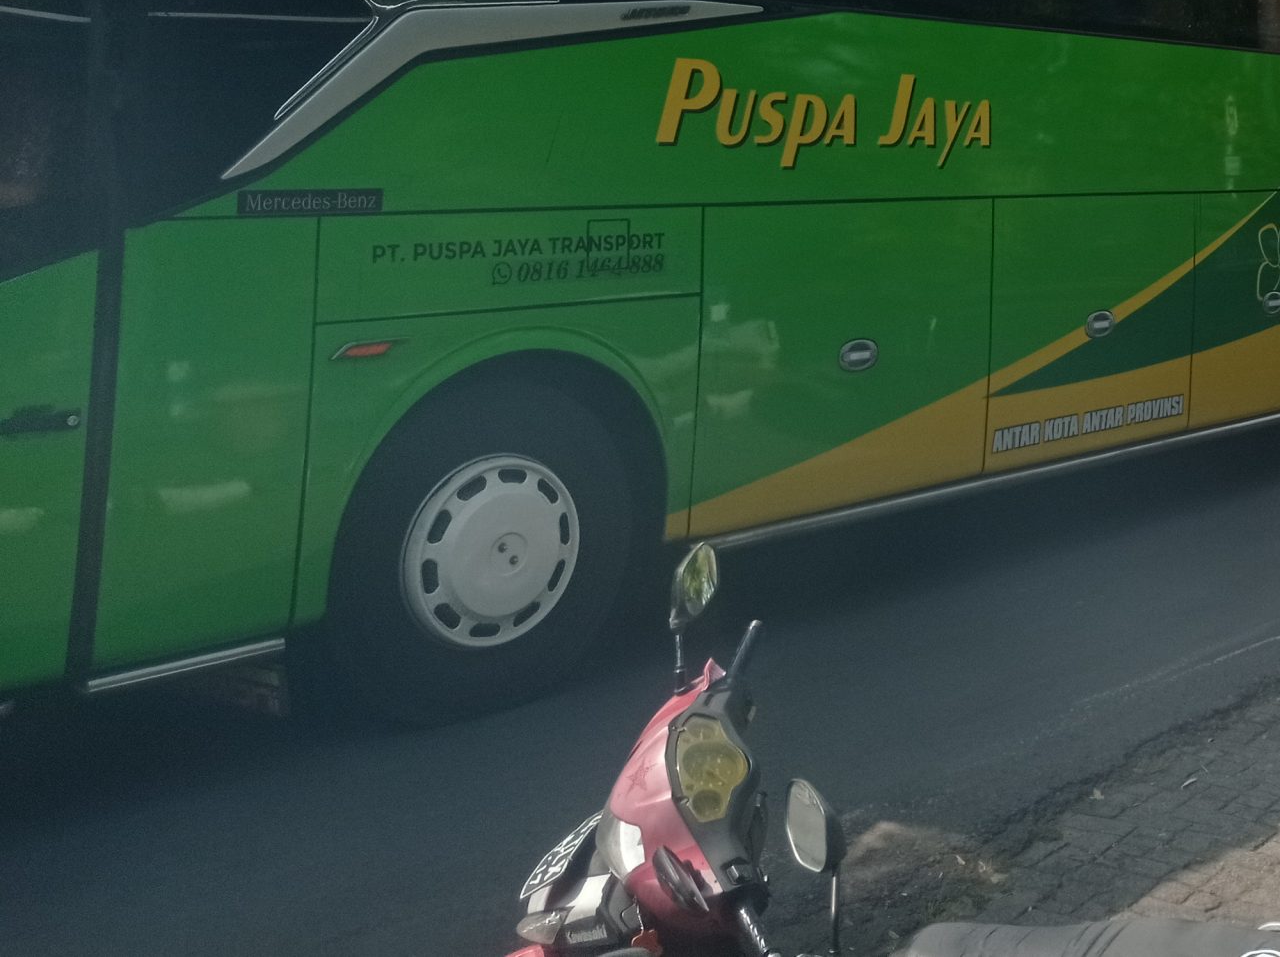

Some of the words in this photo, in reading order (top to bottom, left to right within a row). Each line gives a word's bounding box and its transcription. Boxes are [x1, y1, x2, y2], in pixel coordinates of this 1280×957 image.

[245, 192, 377, 212] Mercedes-Benz
[371, 245, 405, 264] PT.
[412, 240, 486, 262] PUSPA
[491, 238, 543, 258] JAYA
[548, 232, 665, 256] TRANSPORT
[516, 260, 570, 283] 0816
[627, 252, 665, 274] 888
[991, 421, 1040, 453] ANTAR
[1043, 413, 1079, 442] KOTA
[1081, 405, 1124, 433] ANTAR
[1126, 394, 1185, 424] PROVINSI
